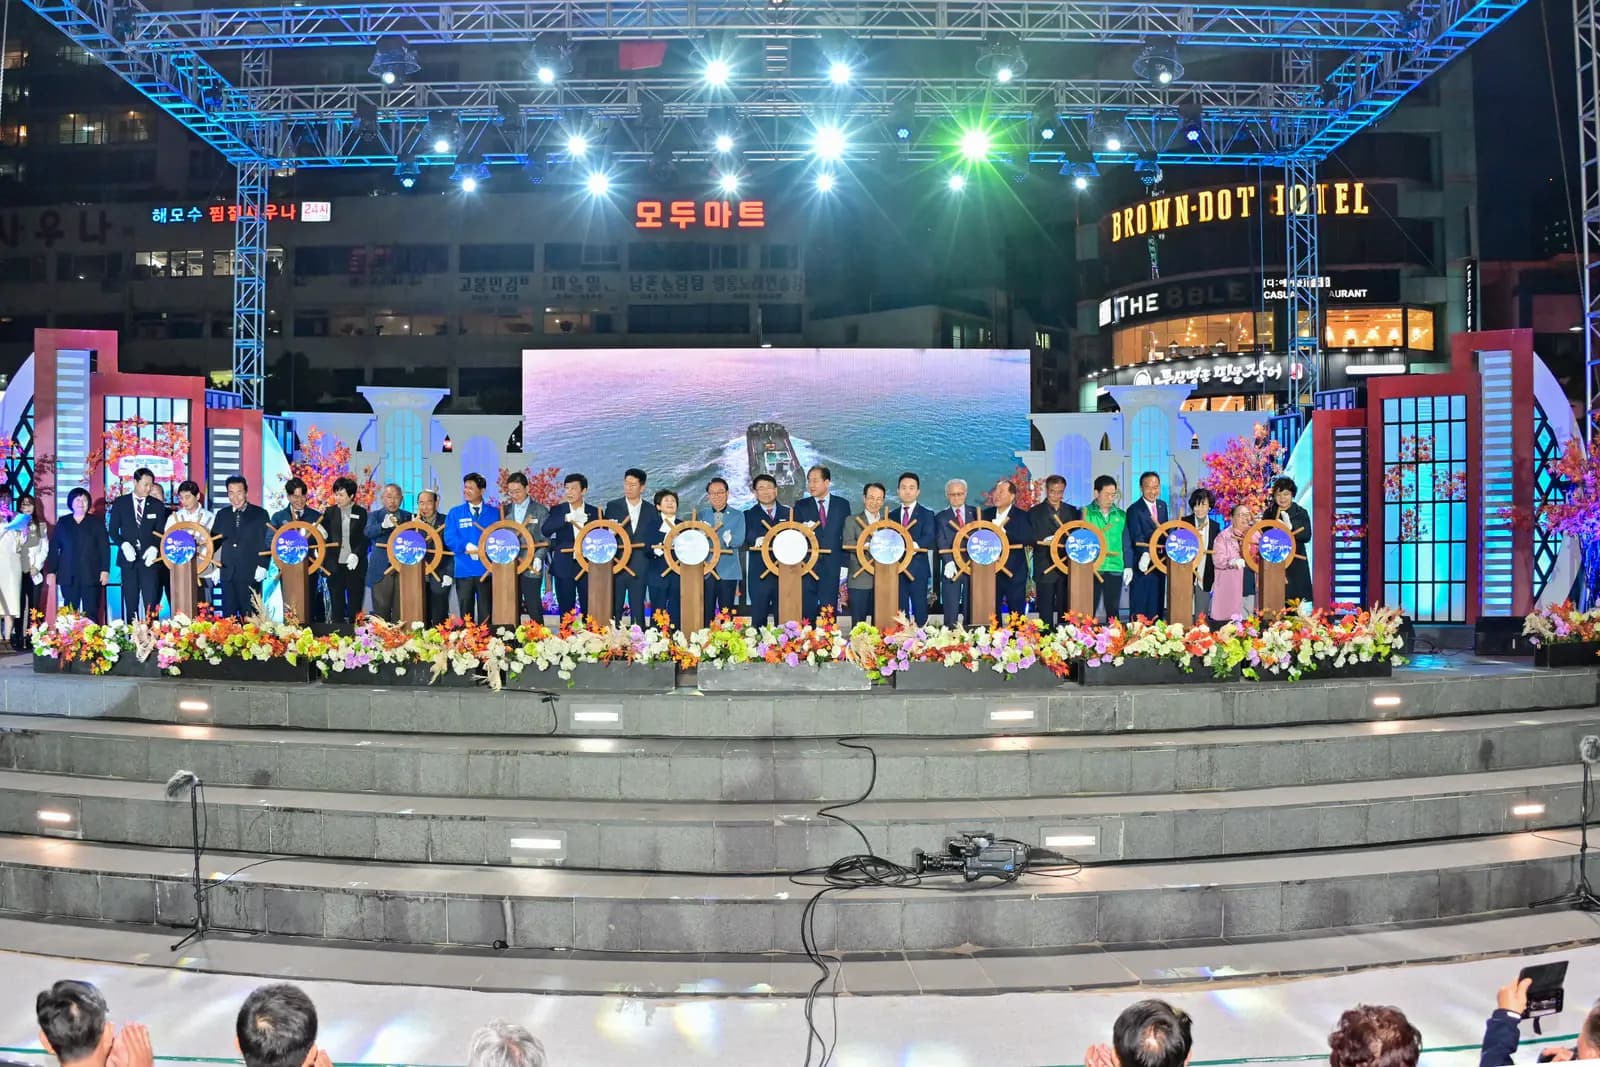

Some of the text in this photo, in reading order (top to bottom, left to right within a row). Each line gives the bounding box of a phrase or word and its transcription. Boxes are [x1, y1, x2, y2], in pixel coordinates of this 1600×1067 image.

[1269, 183, 1370, 216] HOTEL
[152, 206, 203, 224] 해모수
[635, 200, 765, 229] 모두마트
[1118, 292, 1160, 319] THE
